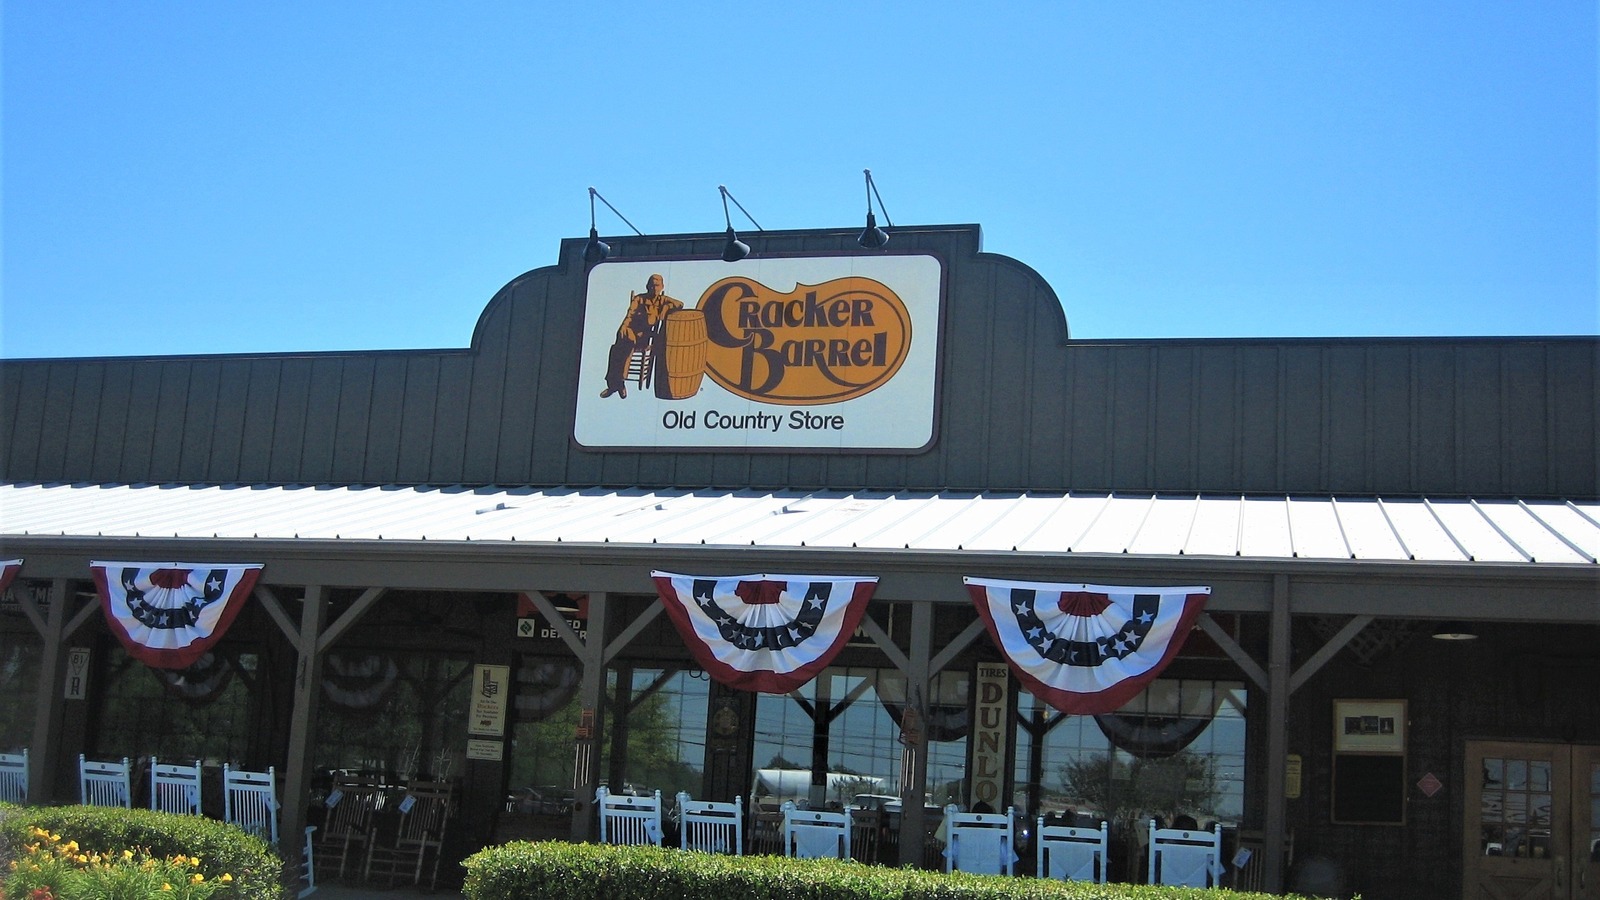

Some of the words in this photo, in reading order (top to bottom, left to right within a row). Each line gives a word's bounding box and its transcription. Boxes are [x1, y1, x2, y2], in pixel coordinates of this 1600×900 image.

[662, 410, 696, 429] Old
[704, 410, 783, 432] Country
[788, 410, 844, 430] Store
[979, 668, 1007, 678] TIRES
[975, 682, 1003, 813] DUNLO
